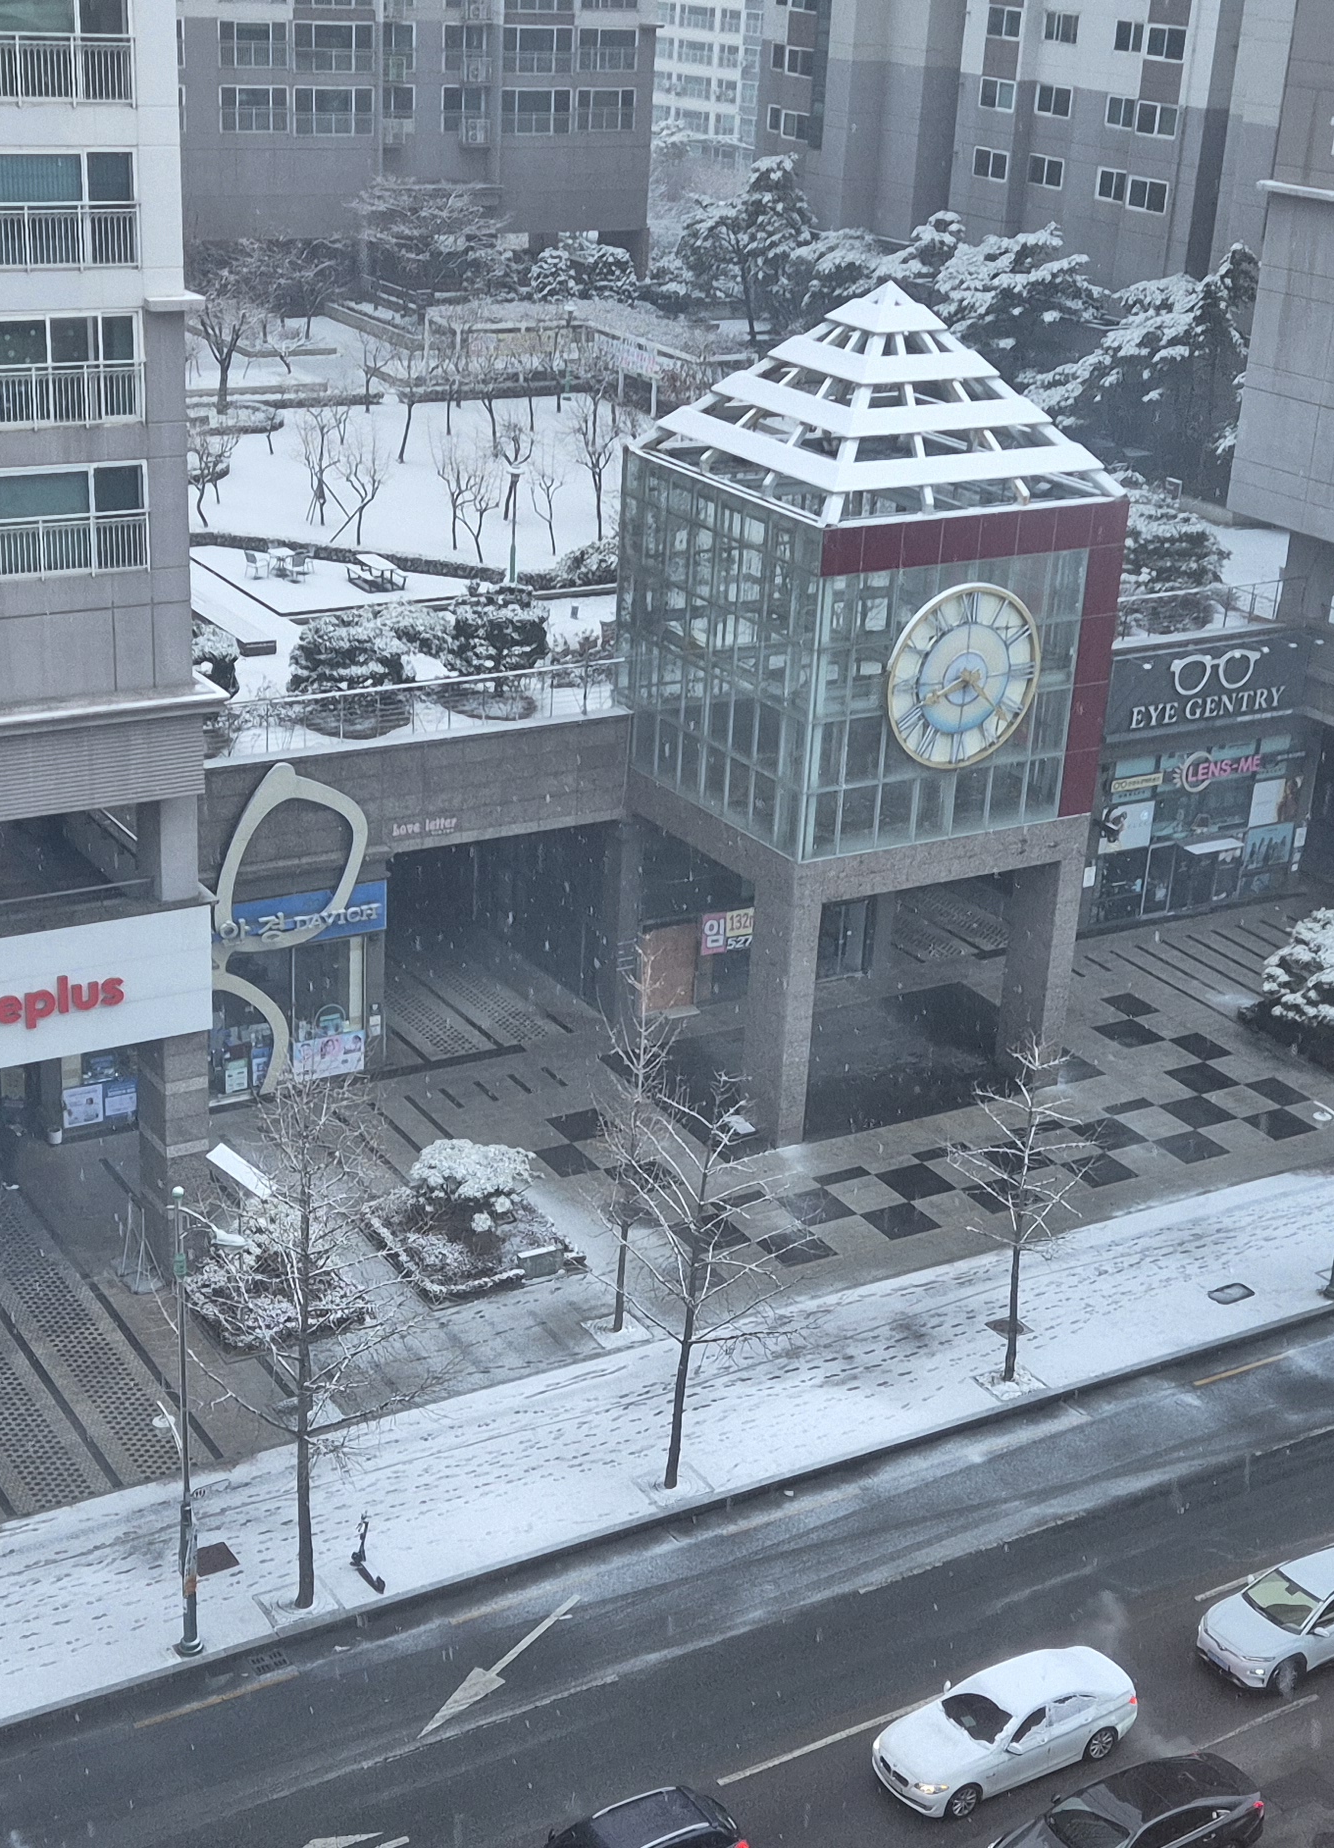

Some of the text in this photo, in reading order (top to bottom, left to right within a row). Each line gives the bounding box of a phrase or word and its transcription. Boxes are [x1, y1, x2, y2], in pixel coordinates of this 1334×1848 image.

[1129, 702, 1179, 730] EYE
[1185, 685, 1286, 720] GENTRY
[1187, 754, 1263, 782] LENS-ME
[294, 902, 382, 931] DAVICH
[704, 918, 725, 949] 임
